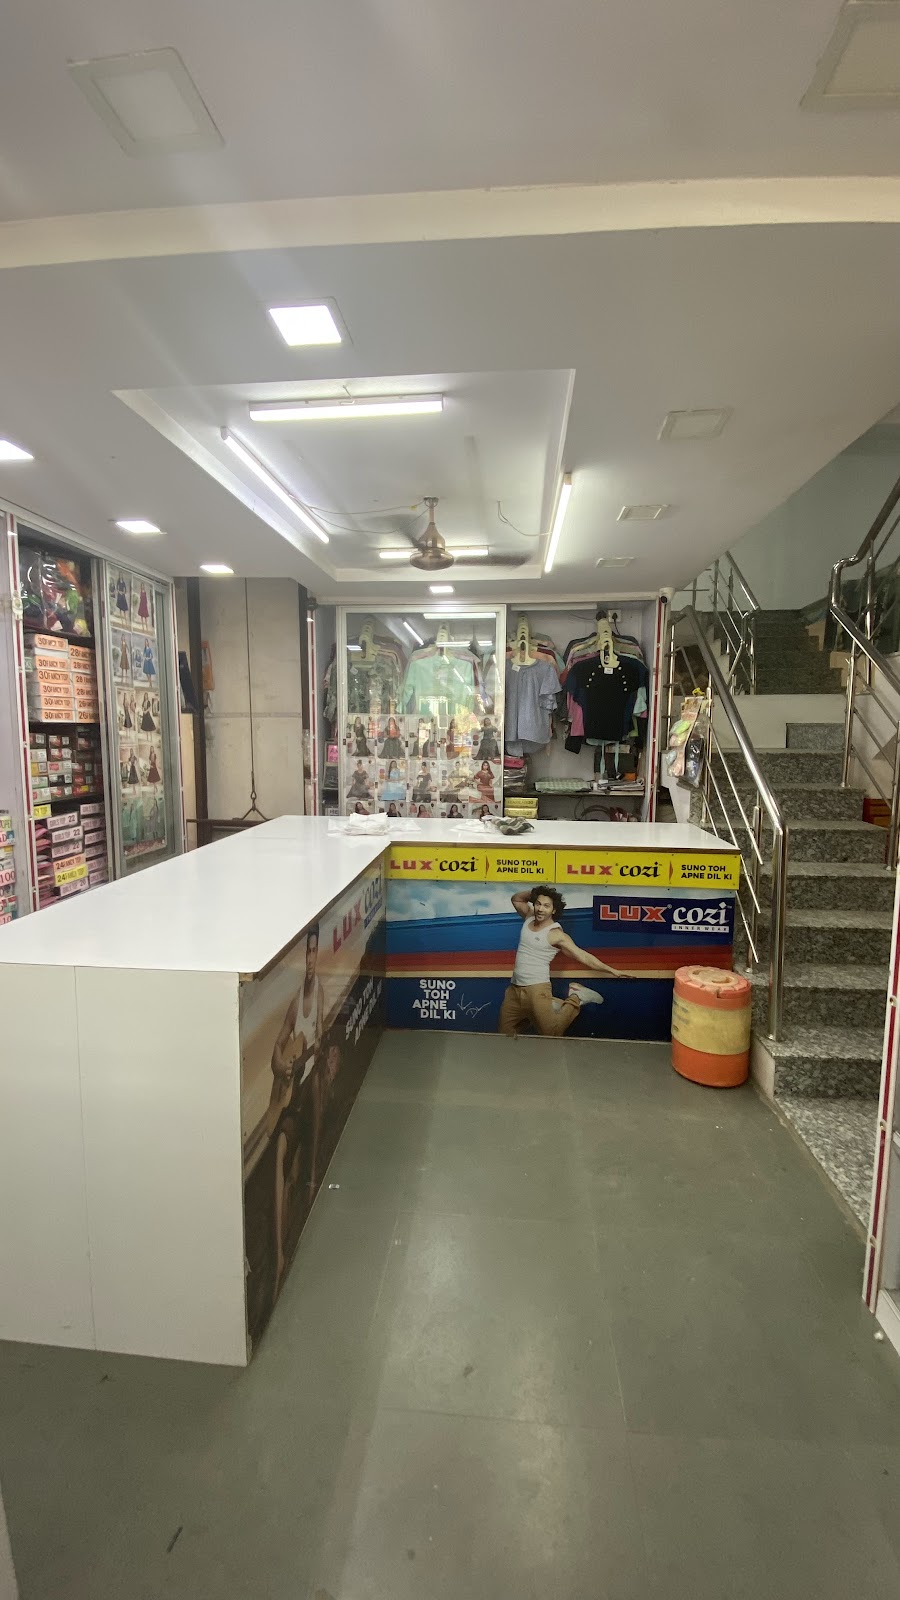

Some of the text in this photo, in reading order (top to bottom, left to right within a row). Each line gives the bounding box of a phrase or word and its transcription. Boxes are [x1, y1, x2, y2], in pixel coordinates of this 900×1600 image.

[390, 857, 478, 872] LUX cozi
[567, 861, 660, 878] LUX cozi
[600, 901, 730, 925] LUX cozi
[333, 897, 362, 954] LUX
[419, 979, 456, 990] SUNO
[424, 989, 449, 999] TOH
[412, 999, 447, 1009] APNE
[420, 1009, 456, 1019] DIL KI
